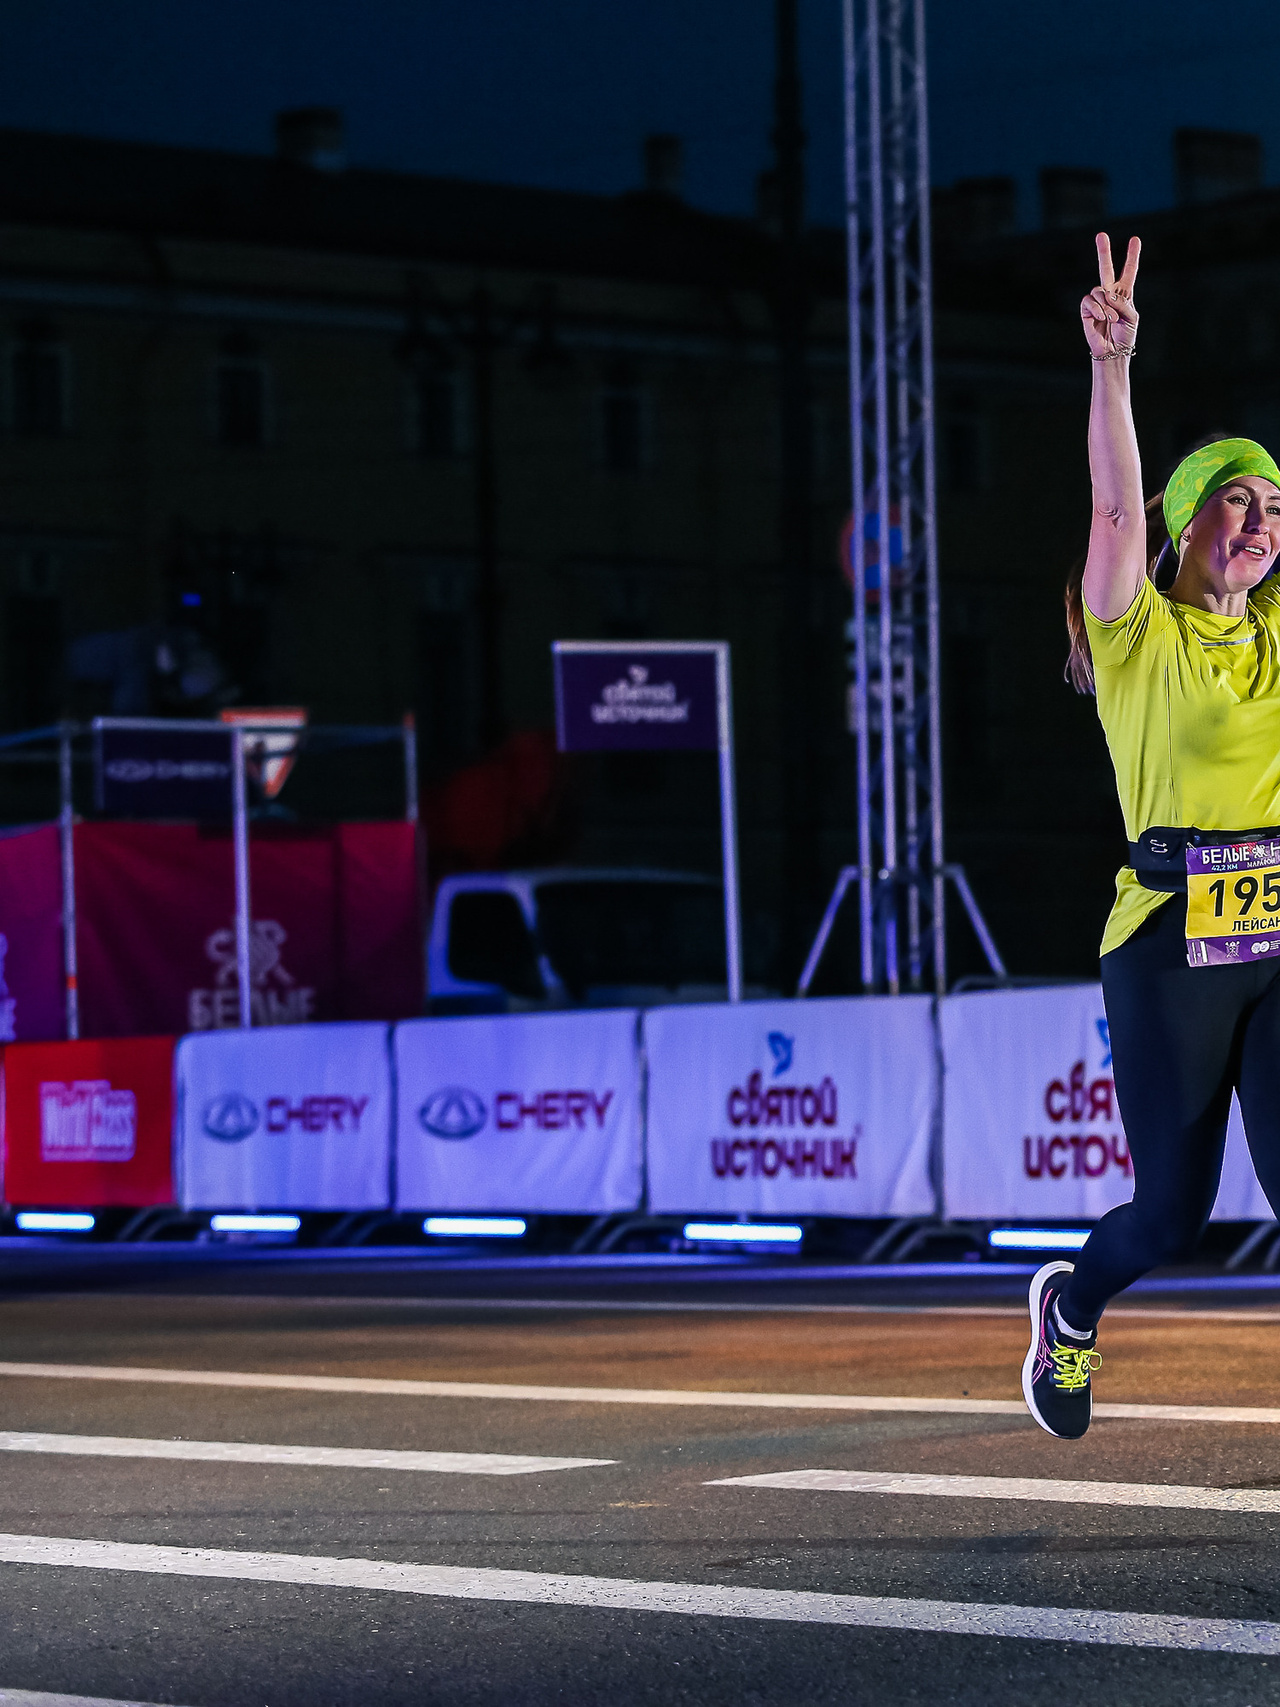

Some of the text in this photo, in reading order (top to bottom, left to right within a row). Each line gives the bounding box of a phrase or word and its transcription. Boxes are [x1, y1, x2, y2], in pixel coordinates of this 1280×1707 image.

[1202, 845, 1250, 865] БЕЛЫЕ
[267, 1096, 369, 1133] CHERY
[497, 1088, 614, 1131] CHERY
